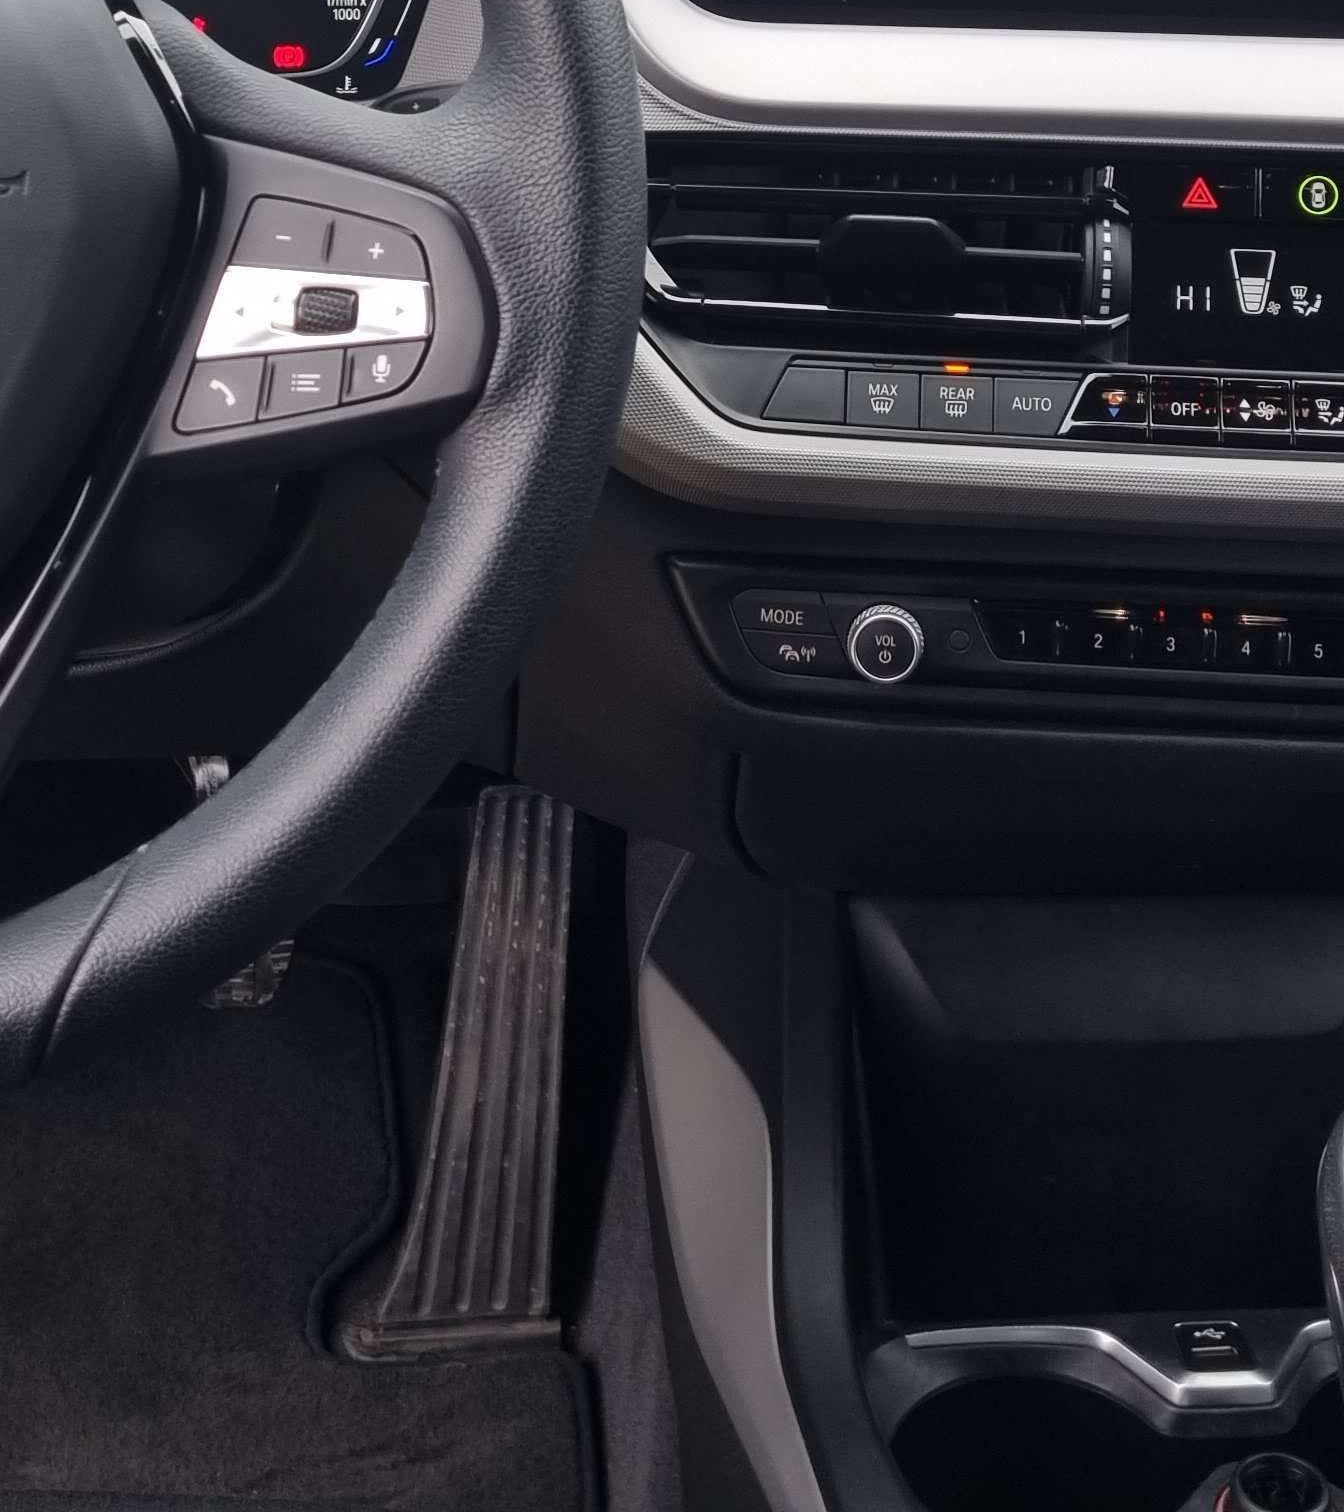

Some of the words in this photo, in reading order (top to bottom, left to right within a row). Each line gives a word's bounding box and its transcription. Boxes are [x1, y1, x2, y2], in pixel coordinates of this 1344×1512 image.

[332, 7, 361, 21] 1000
[868, 383, 899, 397] MAX
[939, 386, 975, 401] REAR
[1011, 396, 1052, 412] AUTO
[1170, 401, 1200, 417] OFF
[760, 607, 804, 626] MODE
[874, 634, 896, 647] VOL
[1313, 643, 1324, 659] 5
